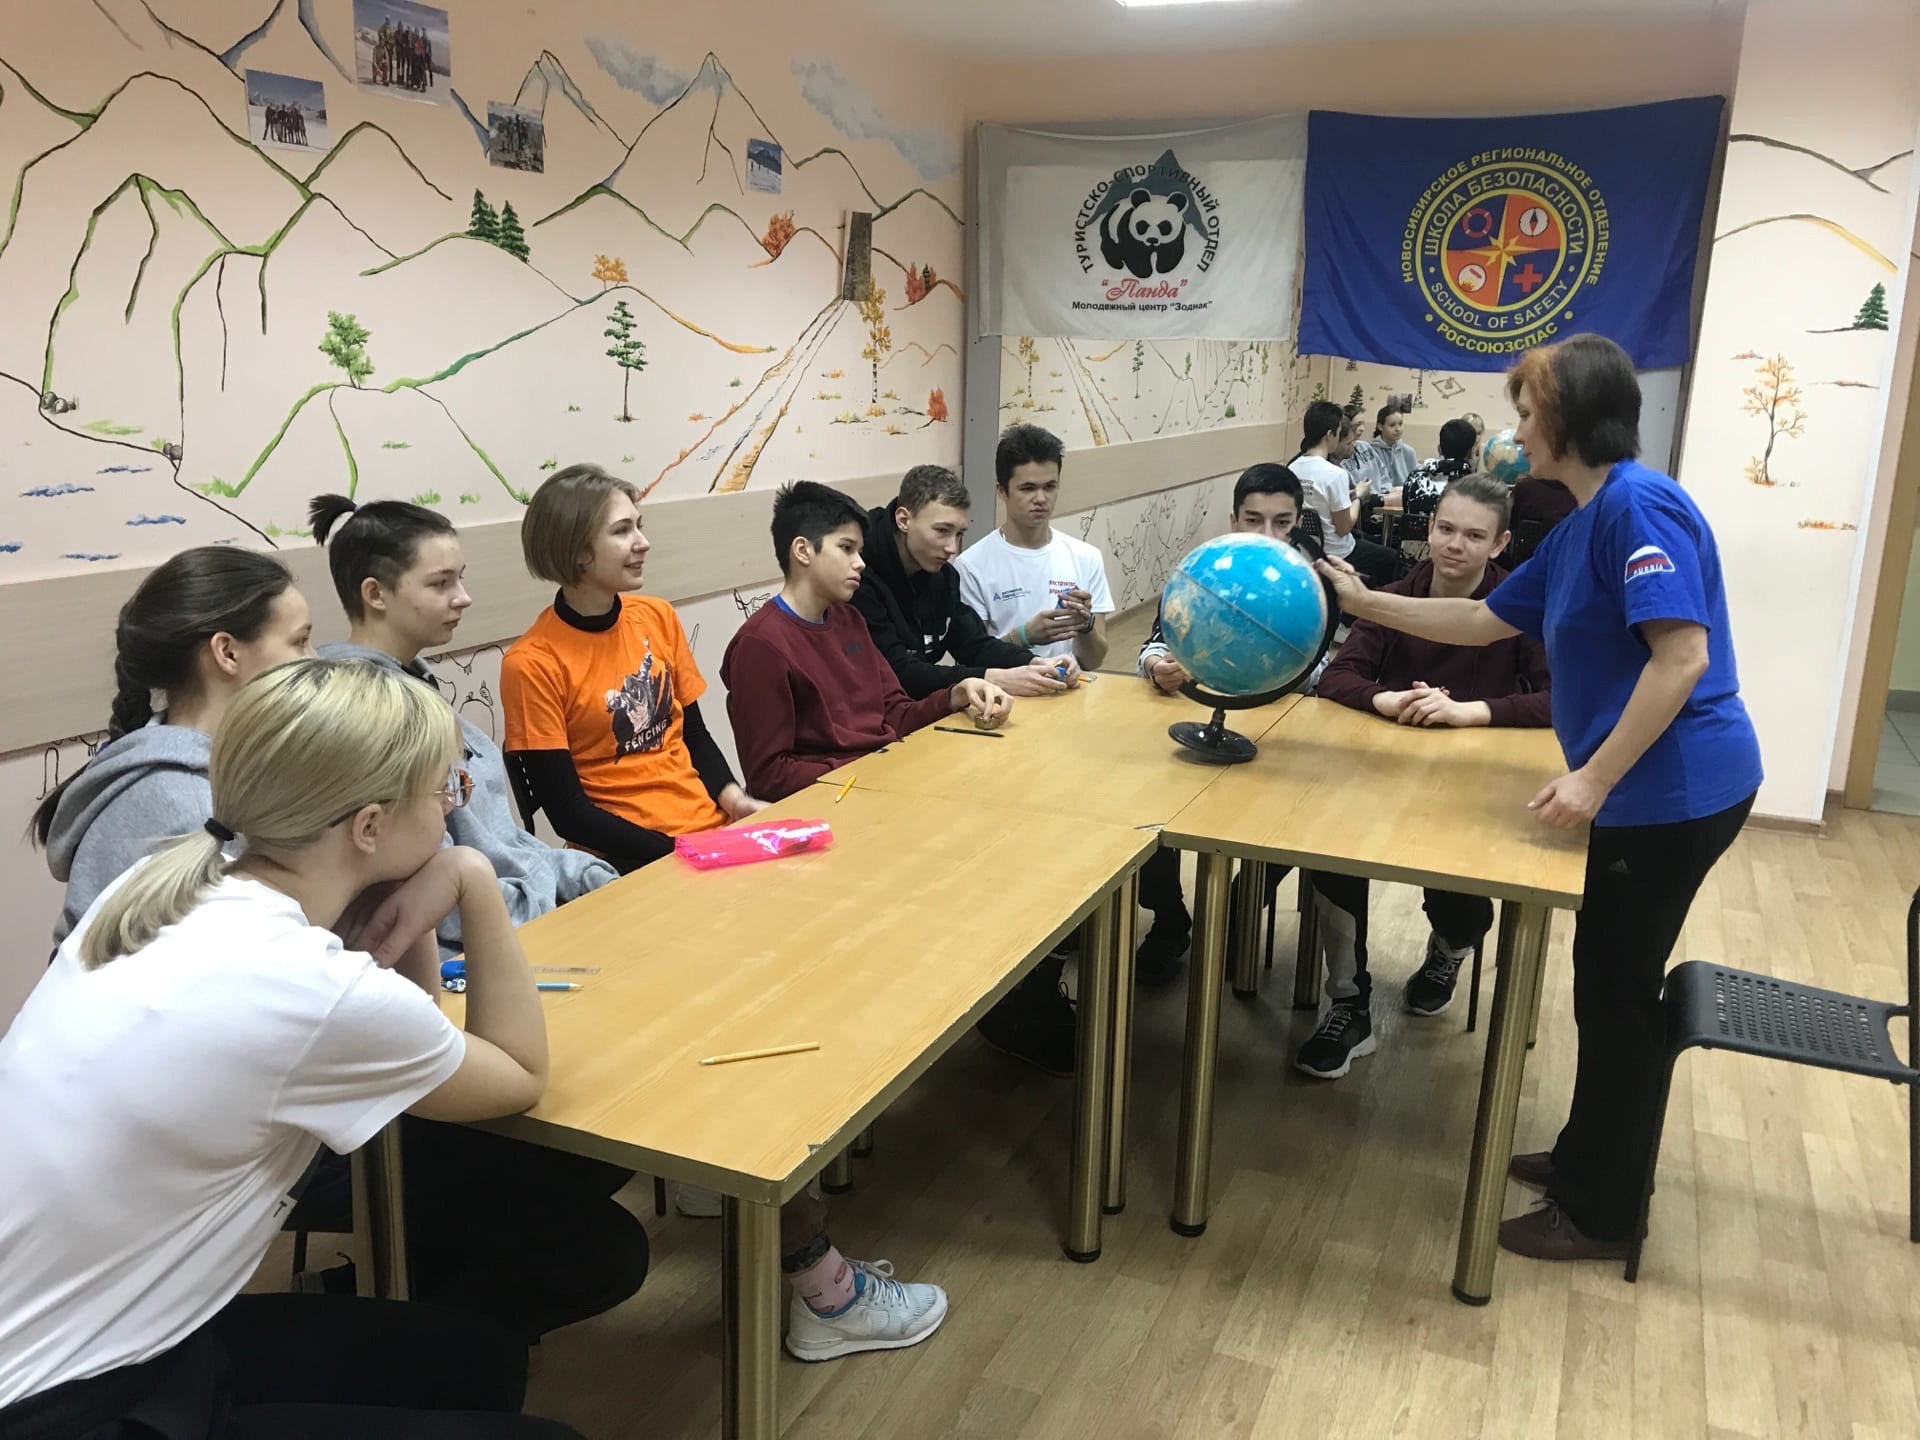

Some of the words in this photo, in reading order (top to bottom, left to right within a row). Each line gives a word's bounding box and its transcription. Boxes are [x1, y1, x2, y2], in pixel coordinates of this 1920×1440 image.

[1401, 161, 1468, 283] НОВОСИБИРСКОЕ
[1471, 148, 1592, 189] РЕГИОНАЛЬНОЕ
[1589, 189, 1609, 286] ОТДЕЛЕНИЕ
[1425, 193, 1467, 256] ШКОЛА
[1467, 171, 1584, 254] БЕЗОПАСНОСТИ
[1197, 215, 1220, 272] ОТДЕЛ
[1072, 301, 1136, 311] Молодежный
[1139, 303, 1168, 312] центр
[1431, 282, 1482, 327] SCHOOL
[1488, 316, 1509, 328] OF
[1514, 280, 1568, 325] SAFETY
[1436, 322, 1558, 354] РОССОЮЗСПАС
[624, 718, 668, 752] FENCING
